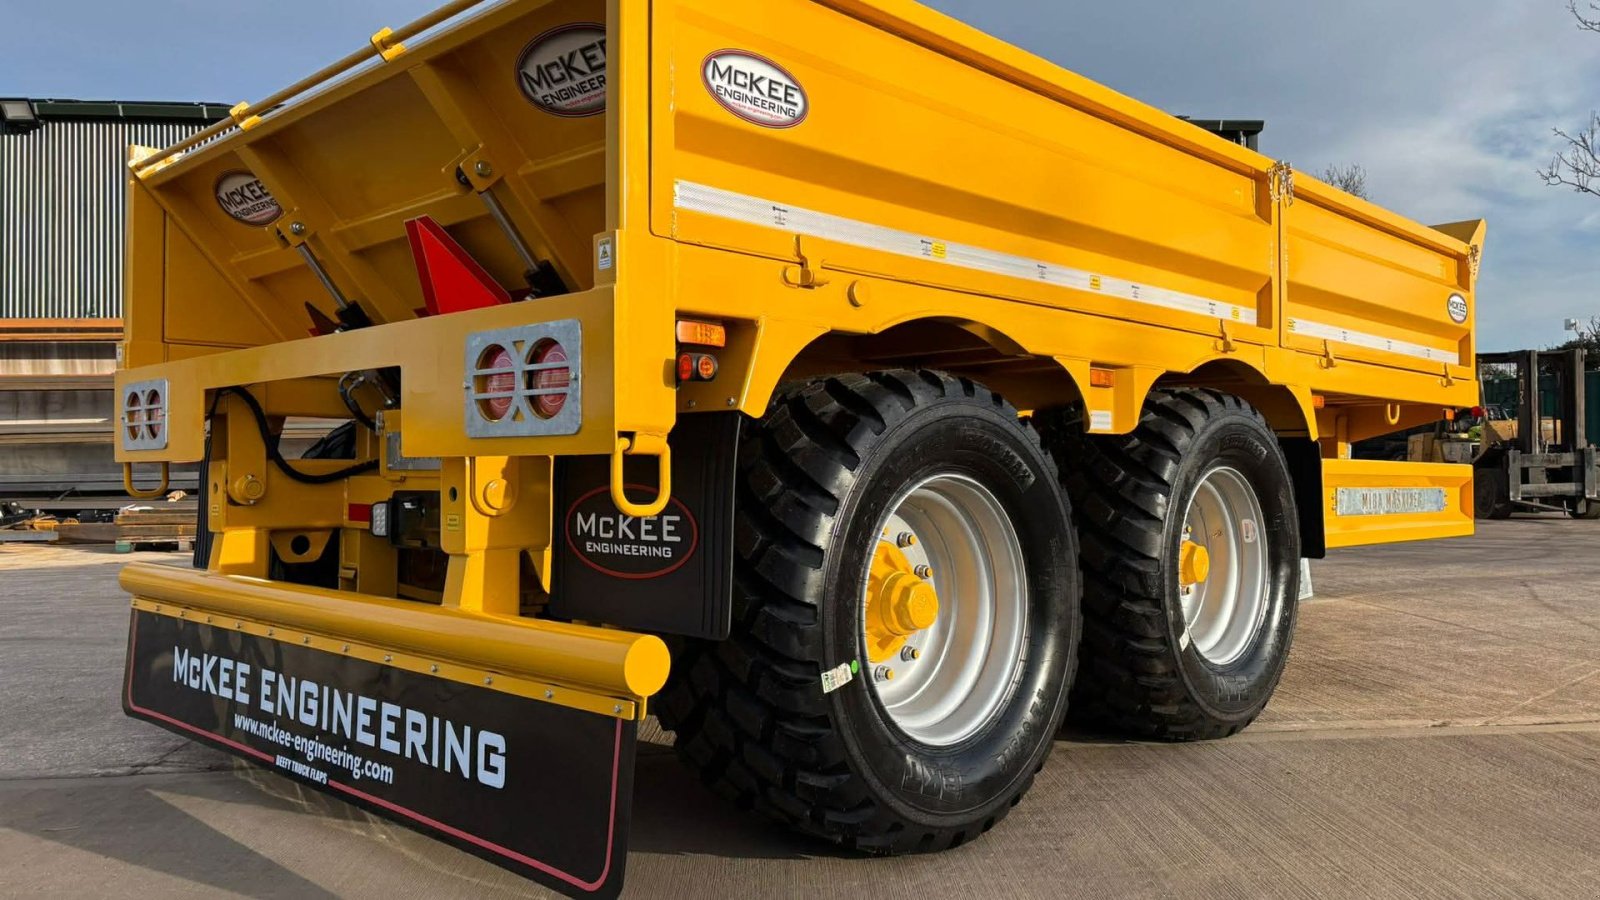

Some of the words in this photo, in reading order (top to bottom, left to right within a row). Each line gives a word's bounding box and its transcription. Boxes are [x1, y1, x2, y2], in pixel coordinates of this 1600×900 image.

[541, 75, 606, 106] ENGINEER
[715, 84, 796, 119] ENGINEERING
[586, 541, 672, 558] ENGINEERING
[260, 668, 507, 790] ENGINEERING
[234, 713, 394, 785] www.mckee-engineering.com
[275, 754, 291, 771] BEEFY
[291, 759, 310, 777] TRUCK
[310, 767, 328, 785] FLAPS
